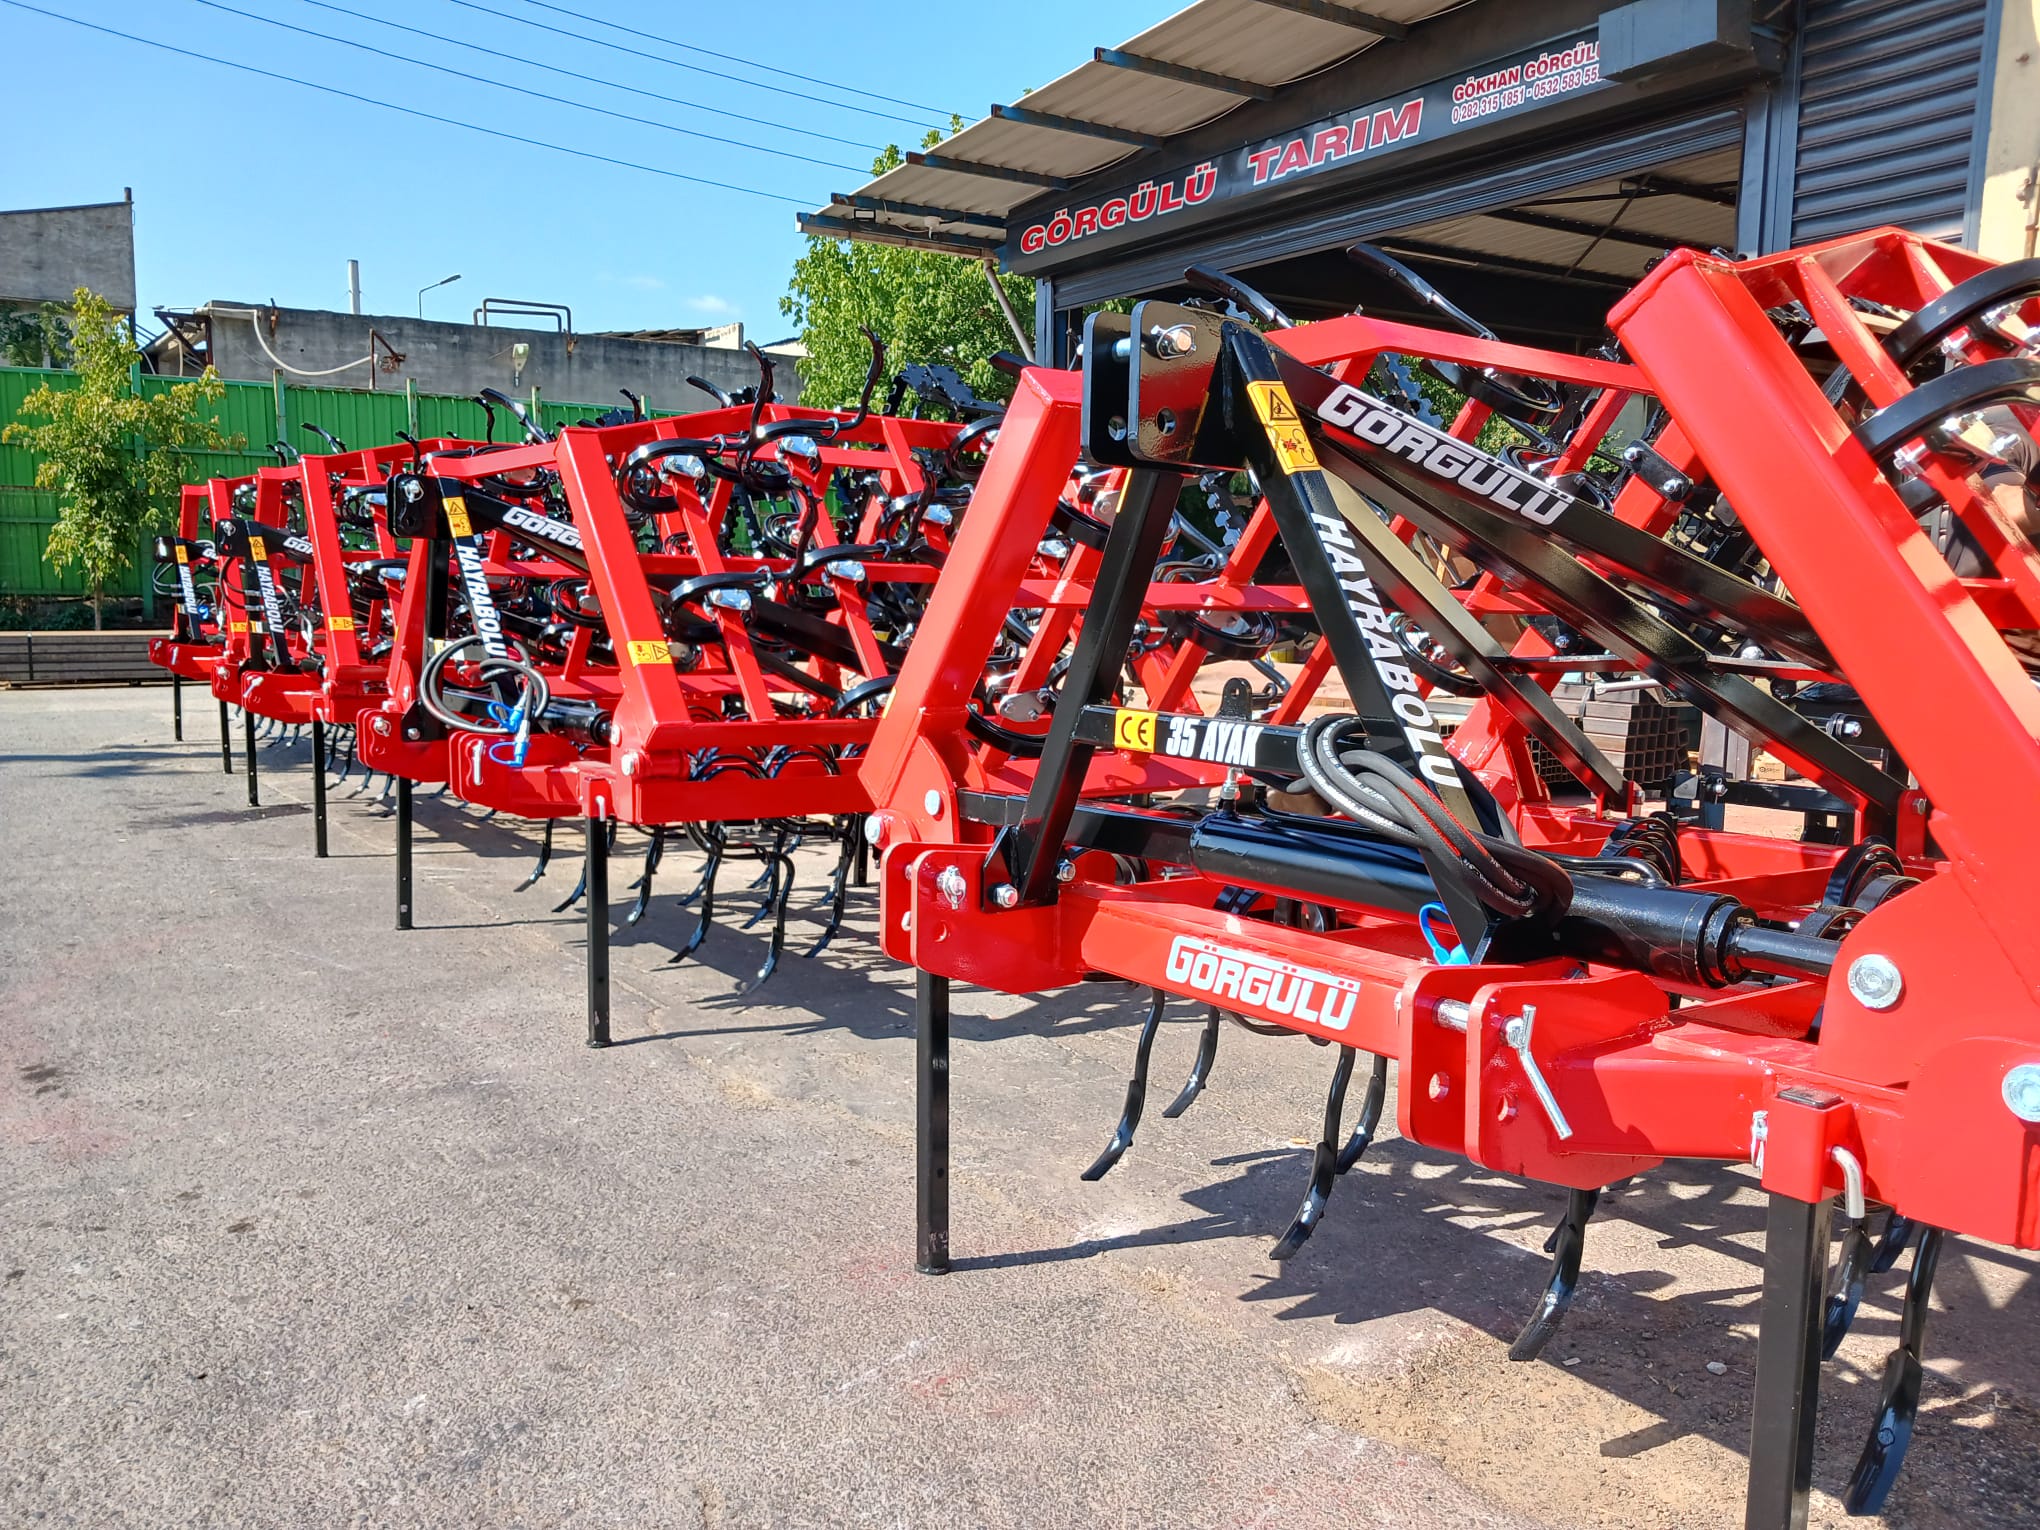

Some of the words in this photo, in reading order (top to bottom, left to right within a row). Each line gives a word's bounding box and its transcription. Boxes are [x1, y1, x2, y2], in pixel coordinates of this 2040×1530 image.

[1452, 105, 1460, 124] 0
[1460, 101, 1479, 121] 282
[1480, 93, 1499, 116] 315
[1500, 86, 1525, 111] 1851
[1533, 78, 1560, 99] 0532
[1560, 69, 1582, 92] 583
[1583, 63, 1600, 86] 55
[1453, 66, 1521, 103] GÖKHAN
[1020, 162, 1217, 255] GÖRGÜLÜ
[1247, 97, 1424, 186] TARIM
[1317, 384, 1575, 526] GÖRGÜLÜ
[257, 565, 285, 634] HAYRABOLU
[456, 545, 508, 657] HAYRABOLU
[1310, 512, 1465, 789] HAYRABOLU
[1121, 716, 1149, 746] CE
[1165, 717, 1200, 757] 35
[1200, 721, 1264, 767] AYAK
[1165, 935, 1361, 1031] GÖRGÜLÜ
